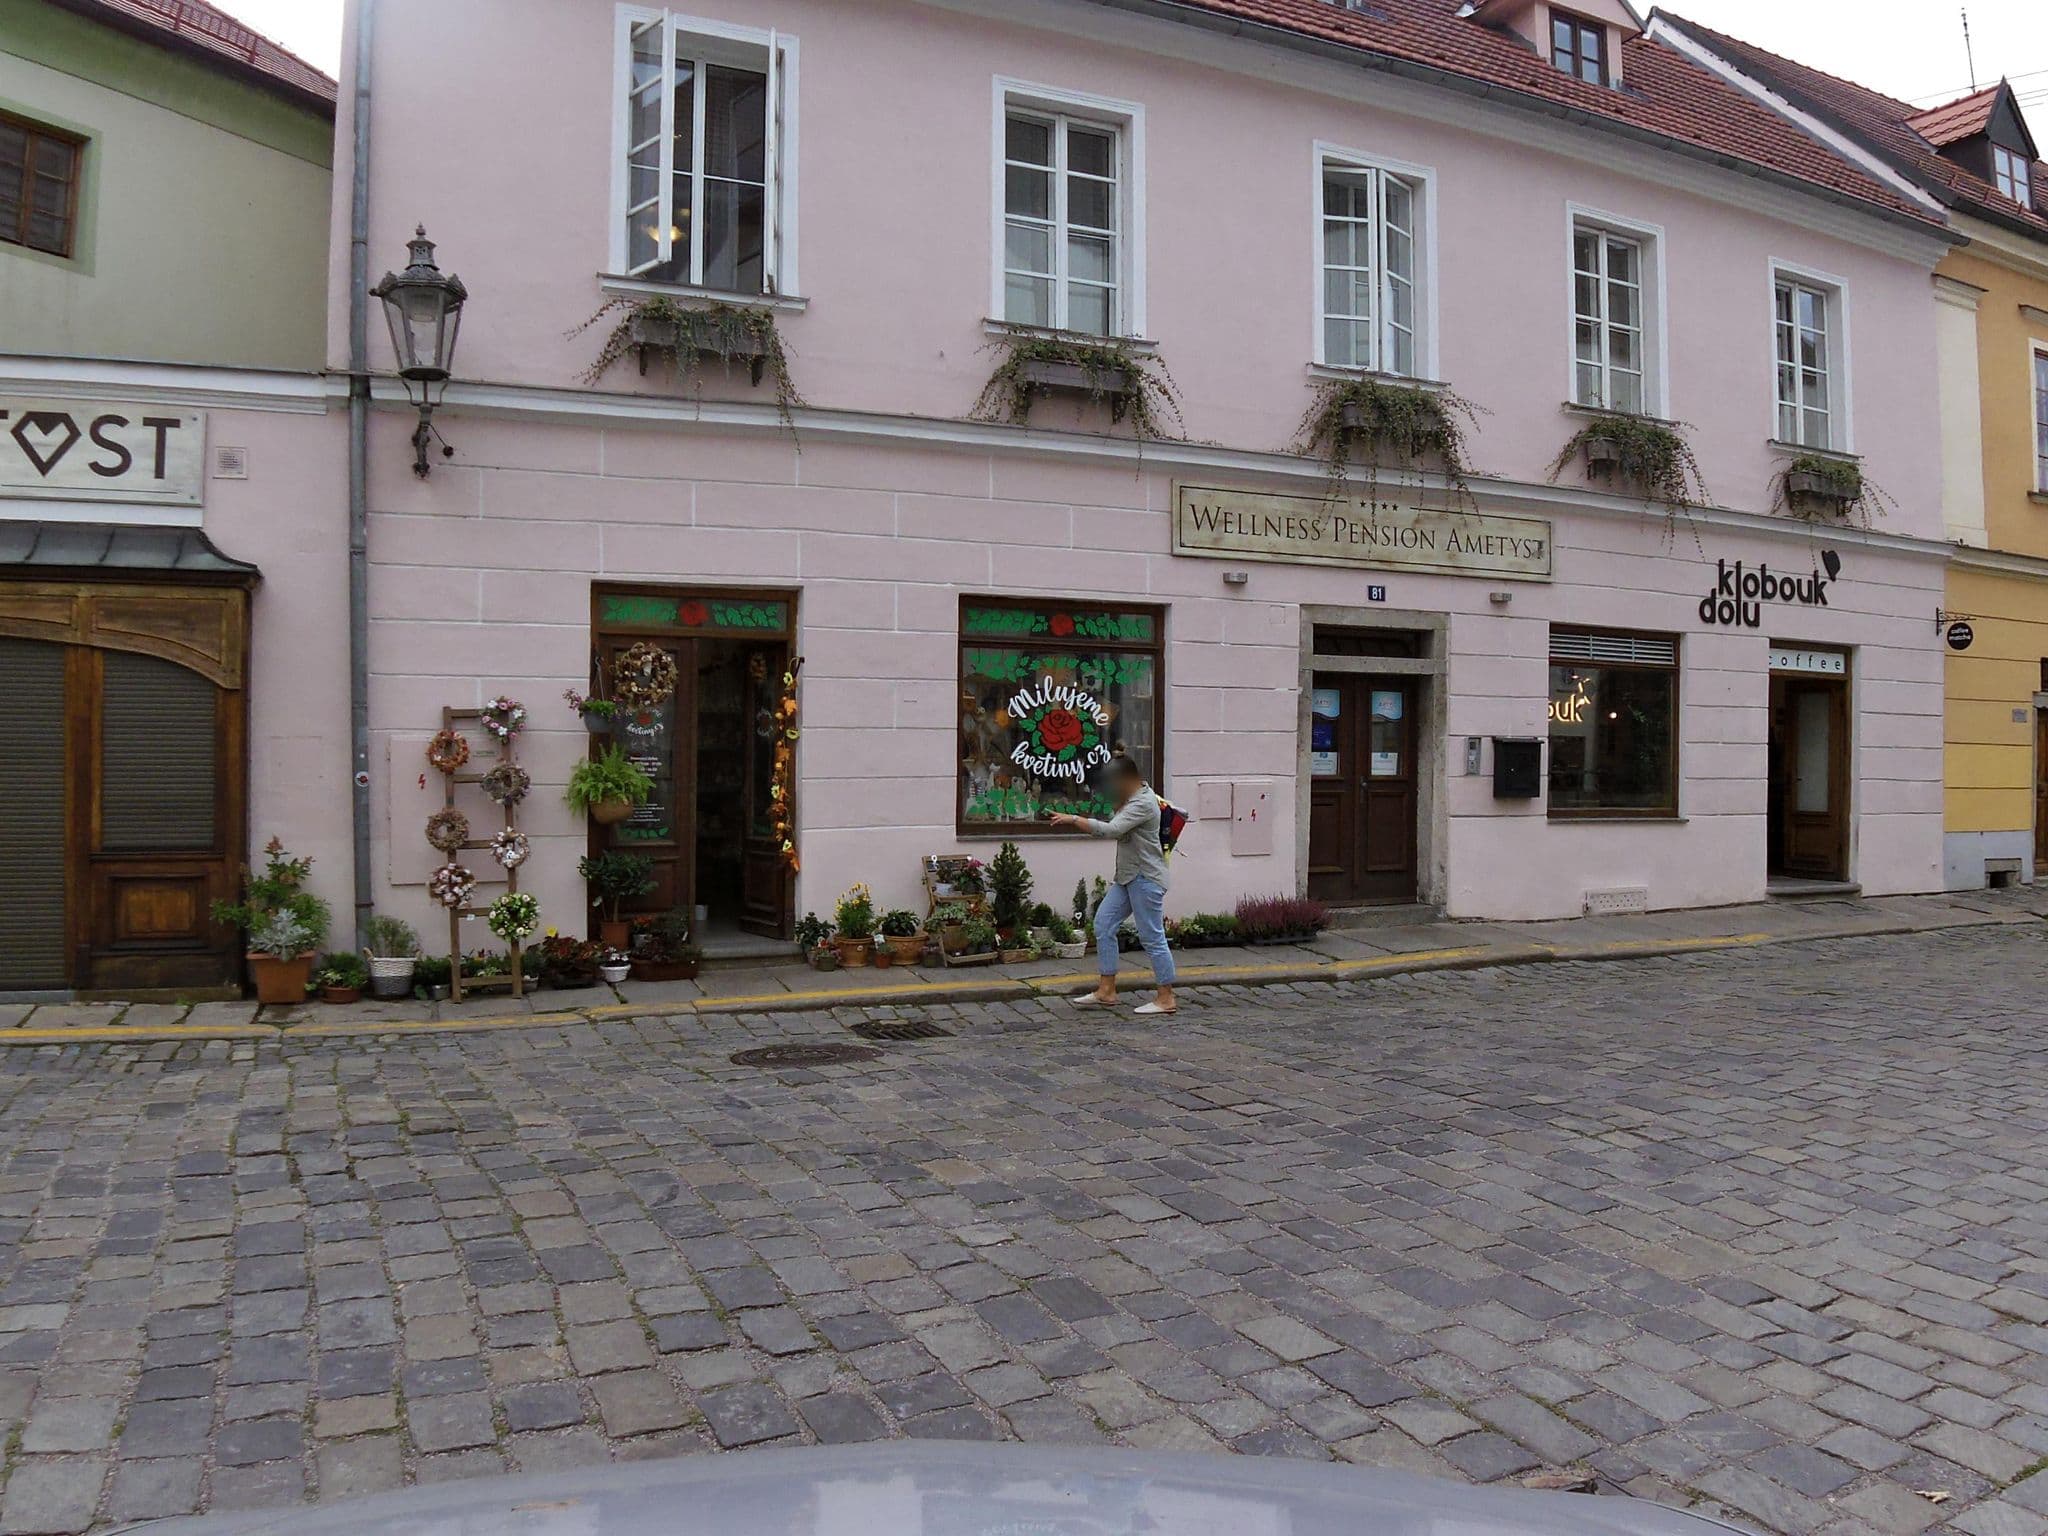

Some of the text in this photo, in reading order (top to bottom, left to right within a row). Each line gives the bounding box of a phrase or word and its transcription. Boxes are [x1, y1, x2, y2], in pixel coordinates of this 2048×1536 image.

[1189, 503, 1545, 560] WELLNESS PENSION AMETYST
[1371, 586, 1383, 600] 81
[1718, 558, 1828, 606] klobouk
[1699, 587, 1761, 628] dolu
[1007, 675, 1110, 726] Milujeme
